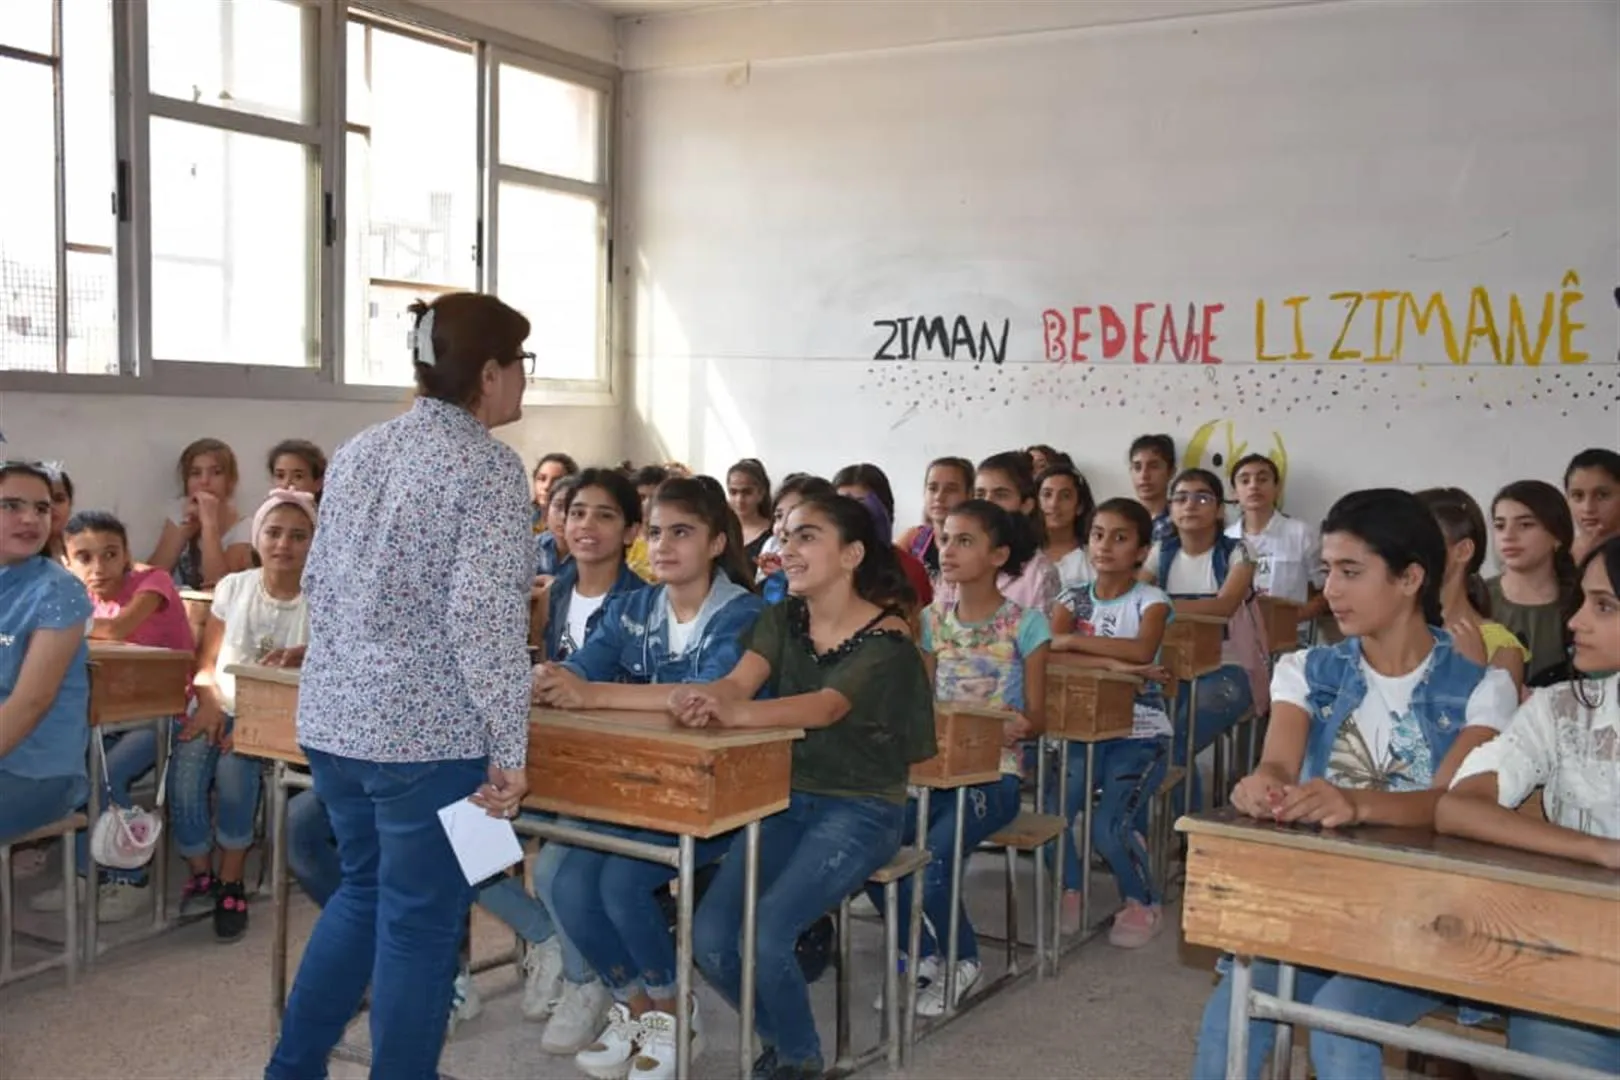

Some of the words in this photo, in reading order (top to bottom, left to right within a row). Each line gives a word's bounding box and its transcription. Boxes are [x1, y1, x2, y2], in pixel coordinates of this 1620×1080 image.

[873, 315, 1009, 364] ZIMAN
[1256, 295, 1313, 361] LI
[1328, 269, 1590, 366] ZIMANÊ
